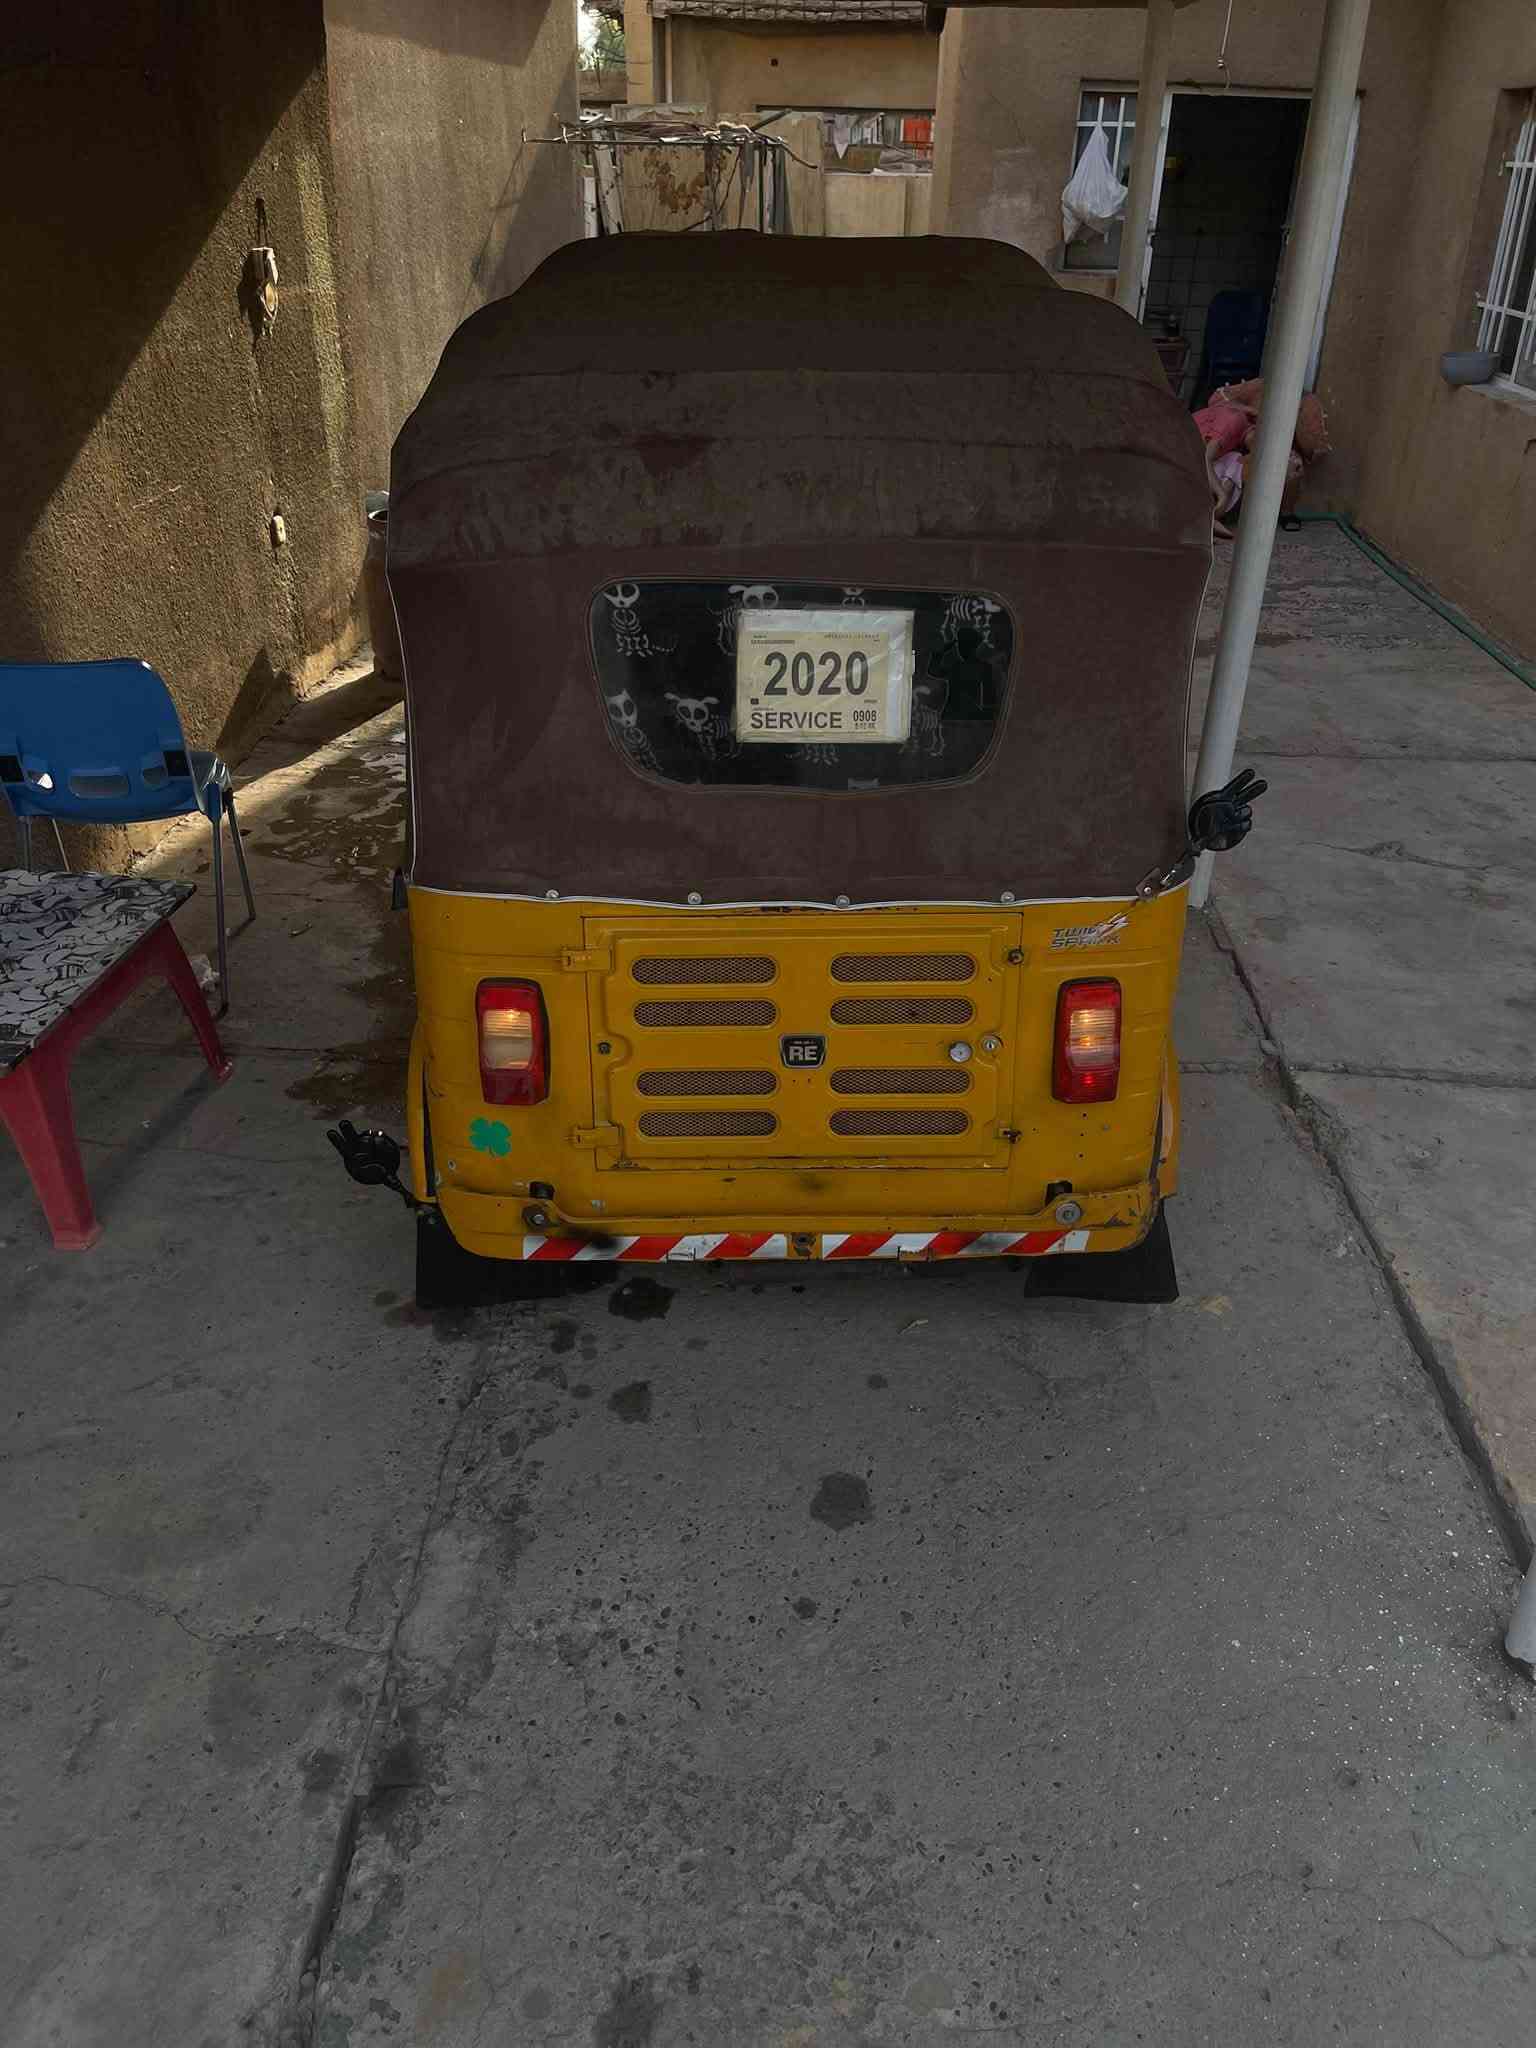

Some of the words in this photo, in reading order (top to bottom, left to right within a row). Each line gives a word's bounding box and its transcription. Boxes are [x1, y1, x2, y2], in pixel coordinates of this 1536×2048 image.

[763, 651, 869, 696] 2020
[750, 711, 843, 729] SERVICE
[789, 1046, 818, 1061] RE
